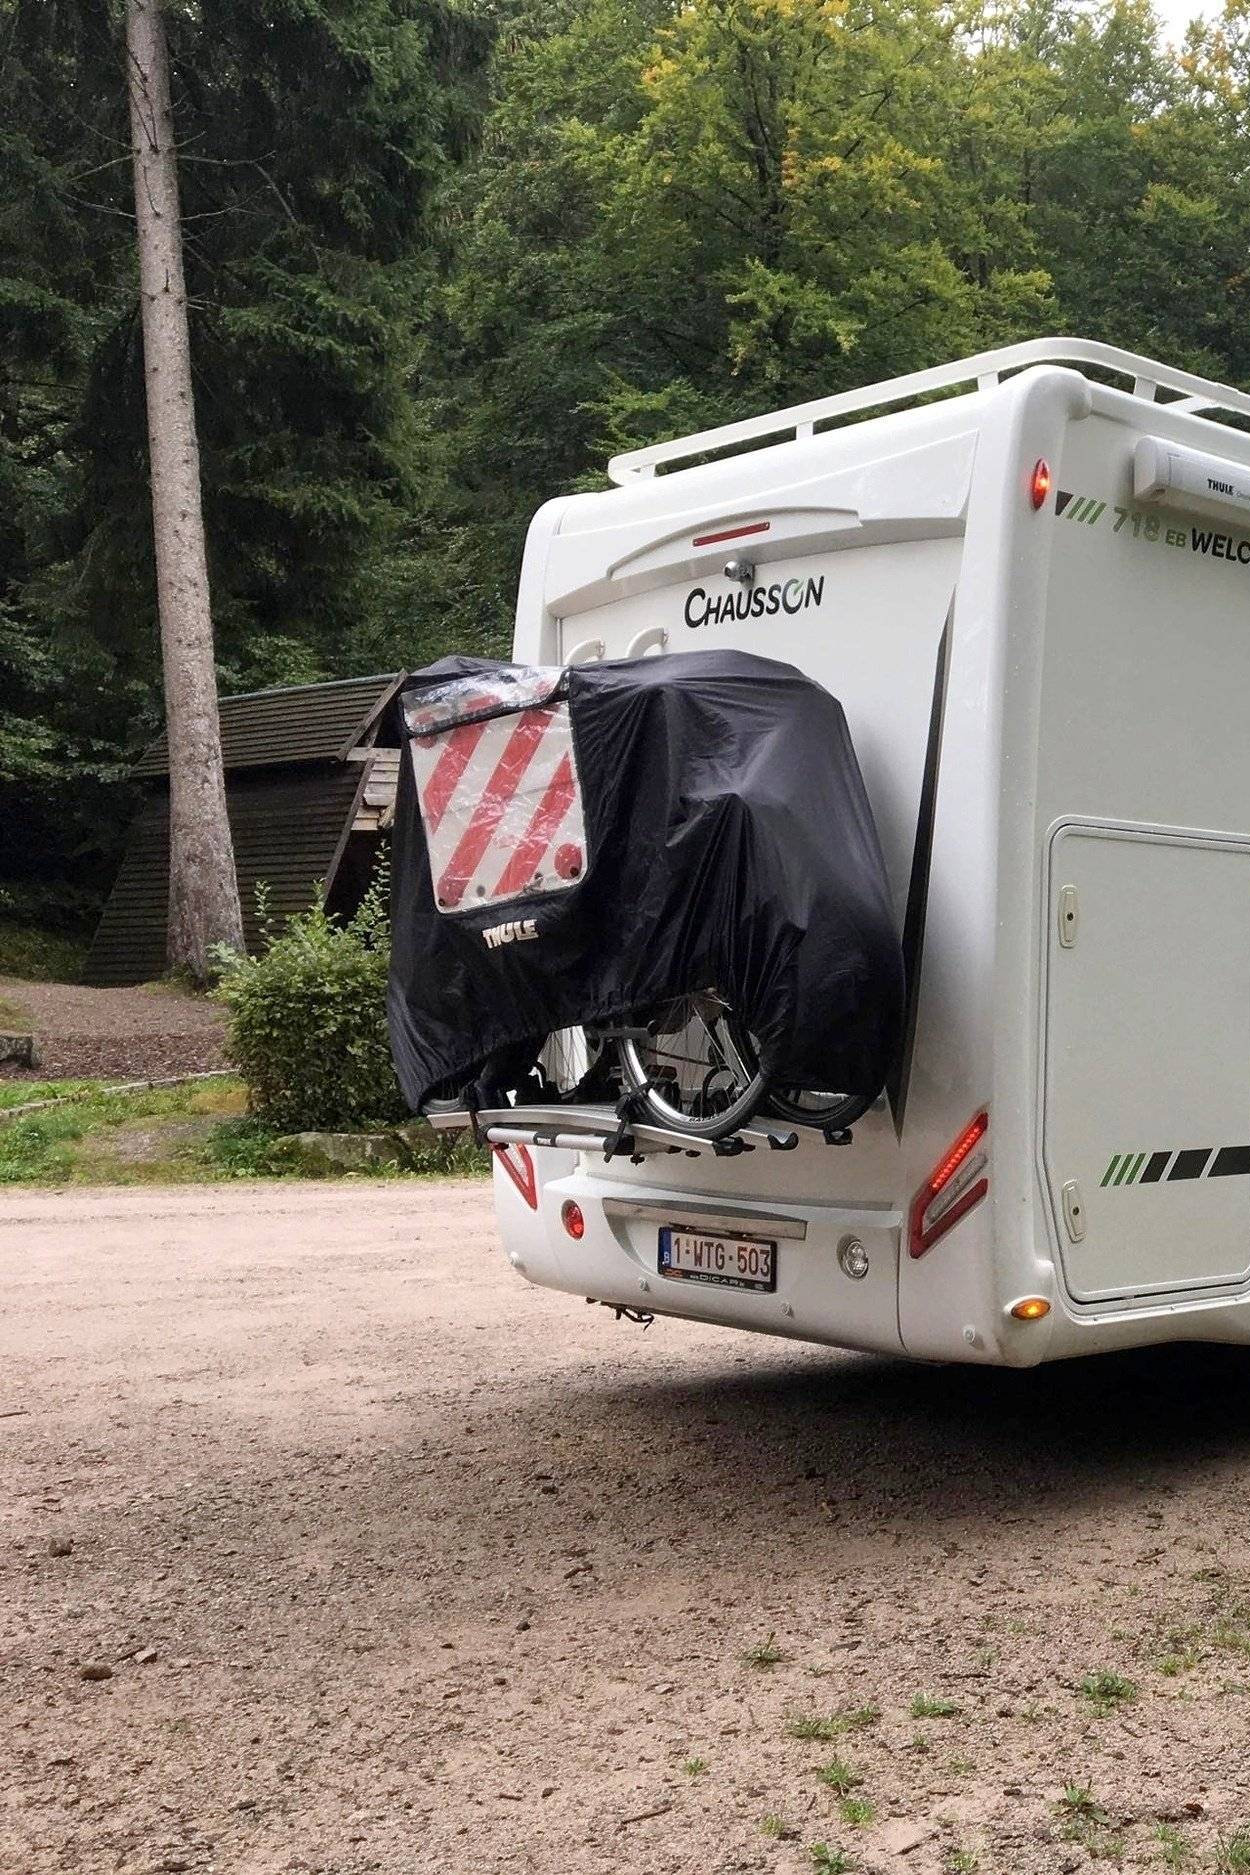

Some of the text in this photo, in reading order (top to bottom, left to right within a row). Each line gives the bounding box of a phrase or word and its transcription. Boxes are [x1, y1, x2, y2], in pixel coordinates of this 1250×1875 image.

[1207, 478, 1234, 496] THULE
[1113, 506, 1160, 542] 718
[1165, 528, 1186, 548] EB
[684, 575, 825, 628] CHAUSSON
[482, 919, 538, 949] THULE
